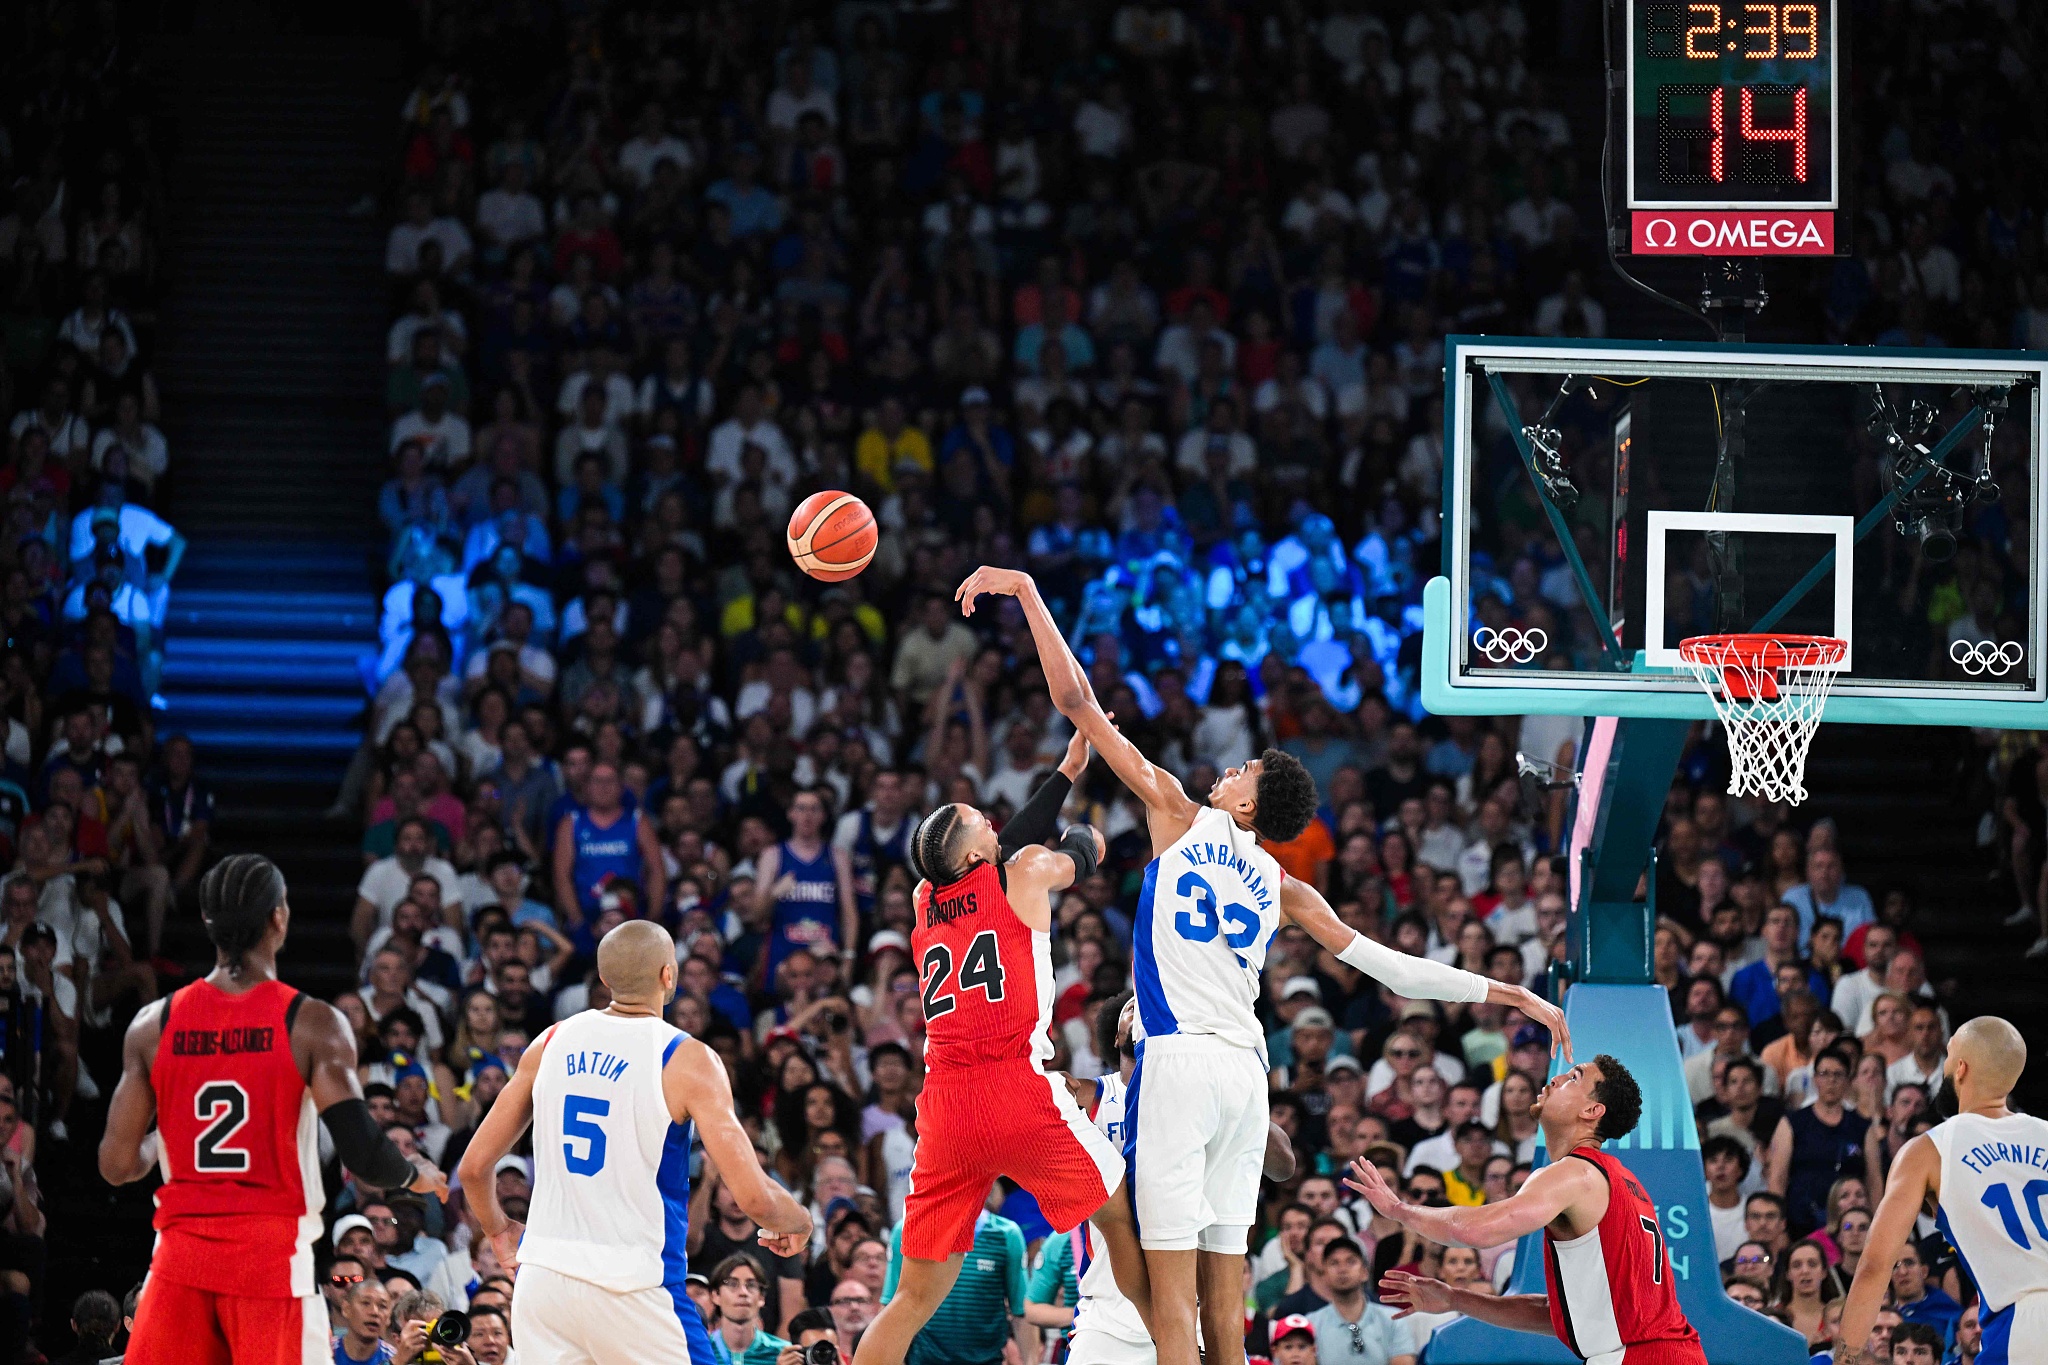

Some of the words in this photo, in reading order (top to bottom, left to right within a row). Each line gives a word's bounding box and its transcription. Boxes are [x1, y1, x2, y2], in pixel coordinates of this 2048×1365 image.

[1686, 4, 1818, 59] 2:39
[1711, 86, 1807, 183] 14
[1688, 218, 1825, 248] OMEGA
[926, 892, 978, 929] BROOKS
[1180, 842, 1273, 911] WEMBANYAMA
[922, 929, 1006, 1023] 24
[567, 1051, 629, 1082] BATUM
[194, 1079, 251, 1173] 2
[563, 1094, 610, 1177] 5
